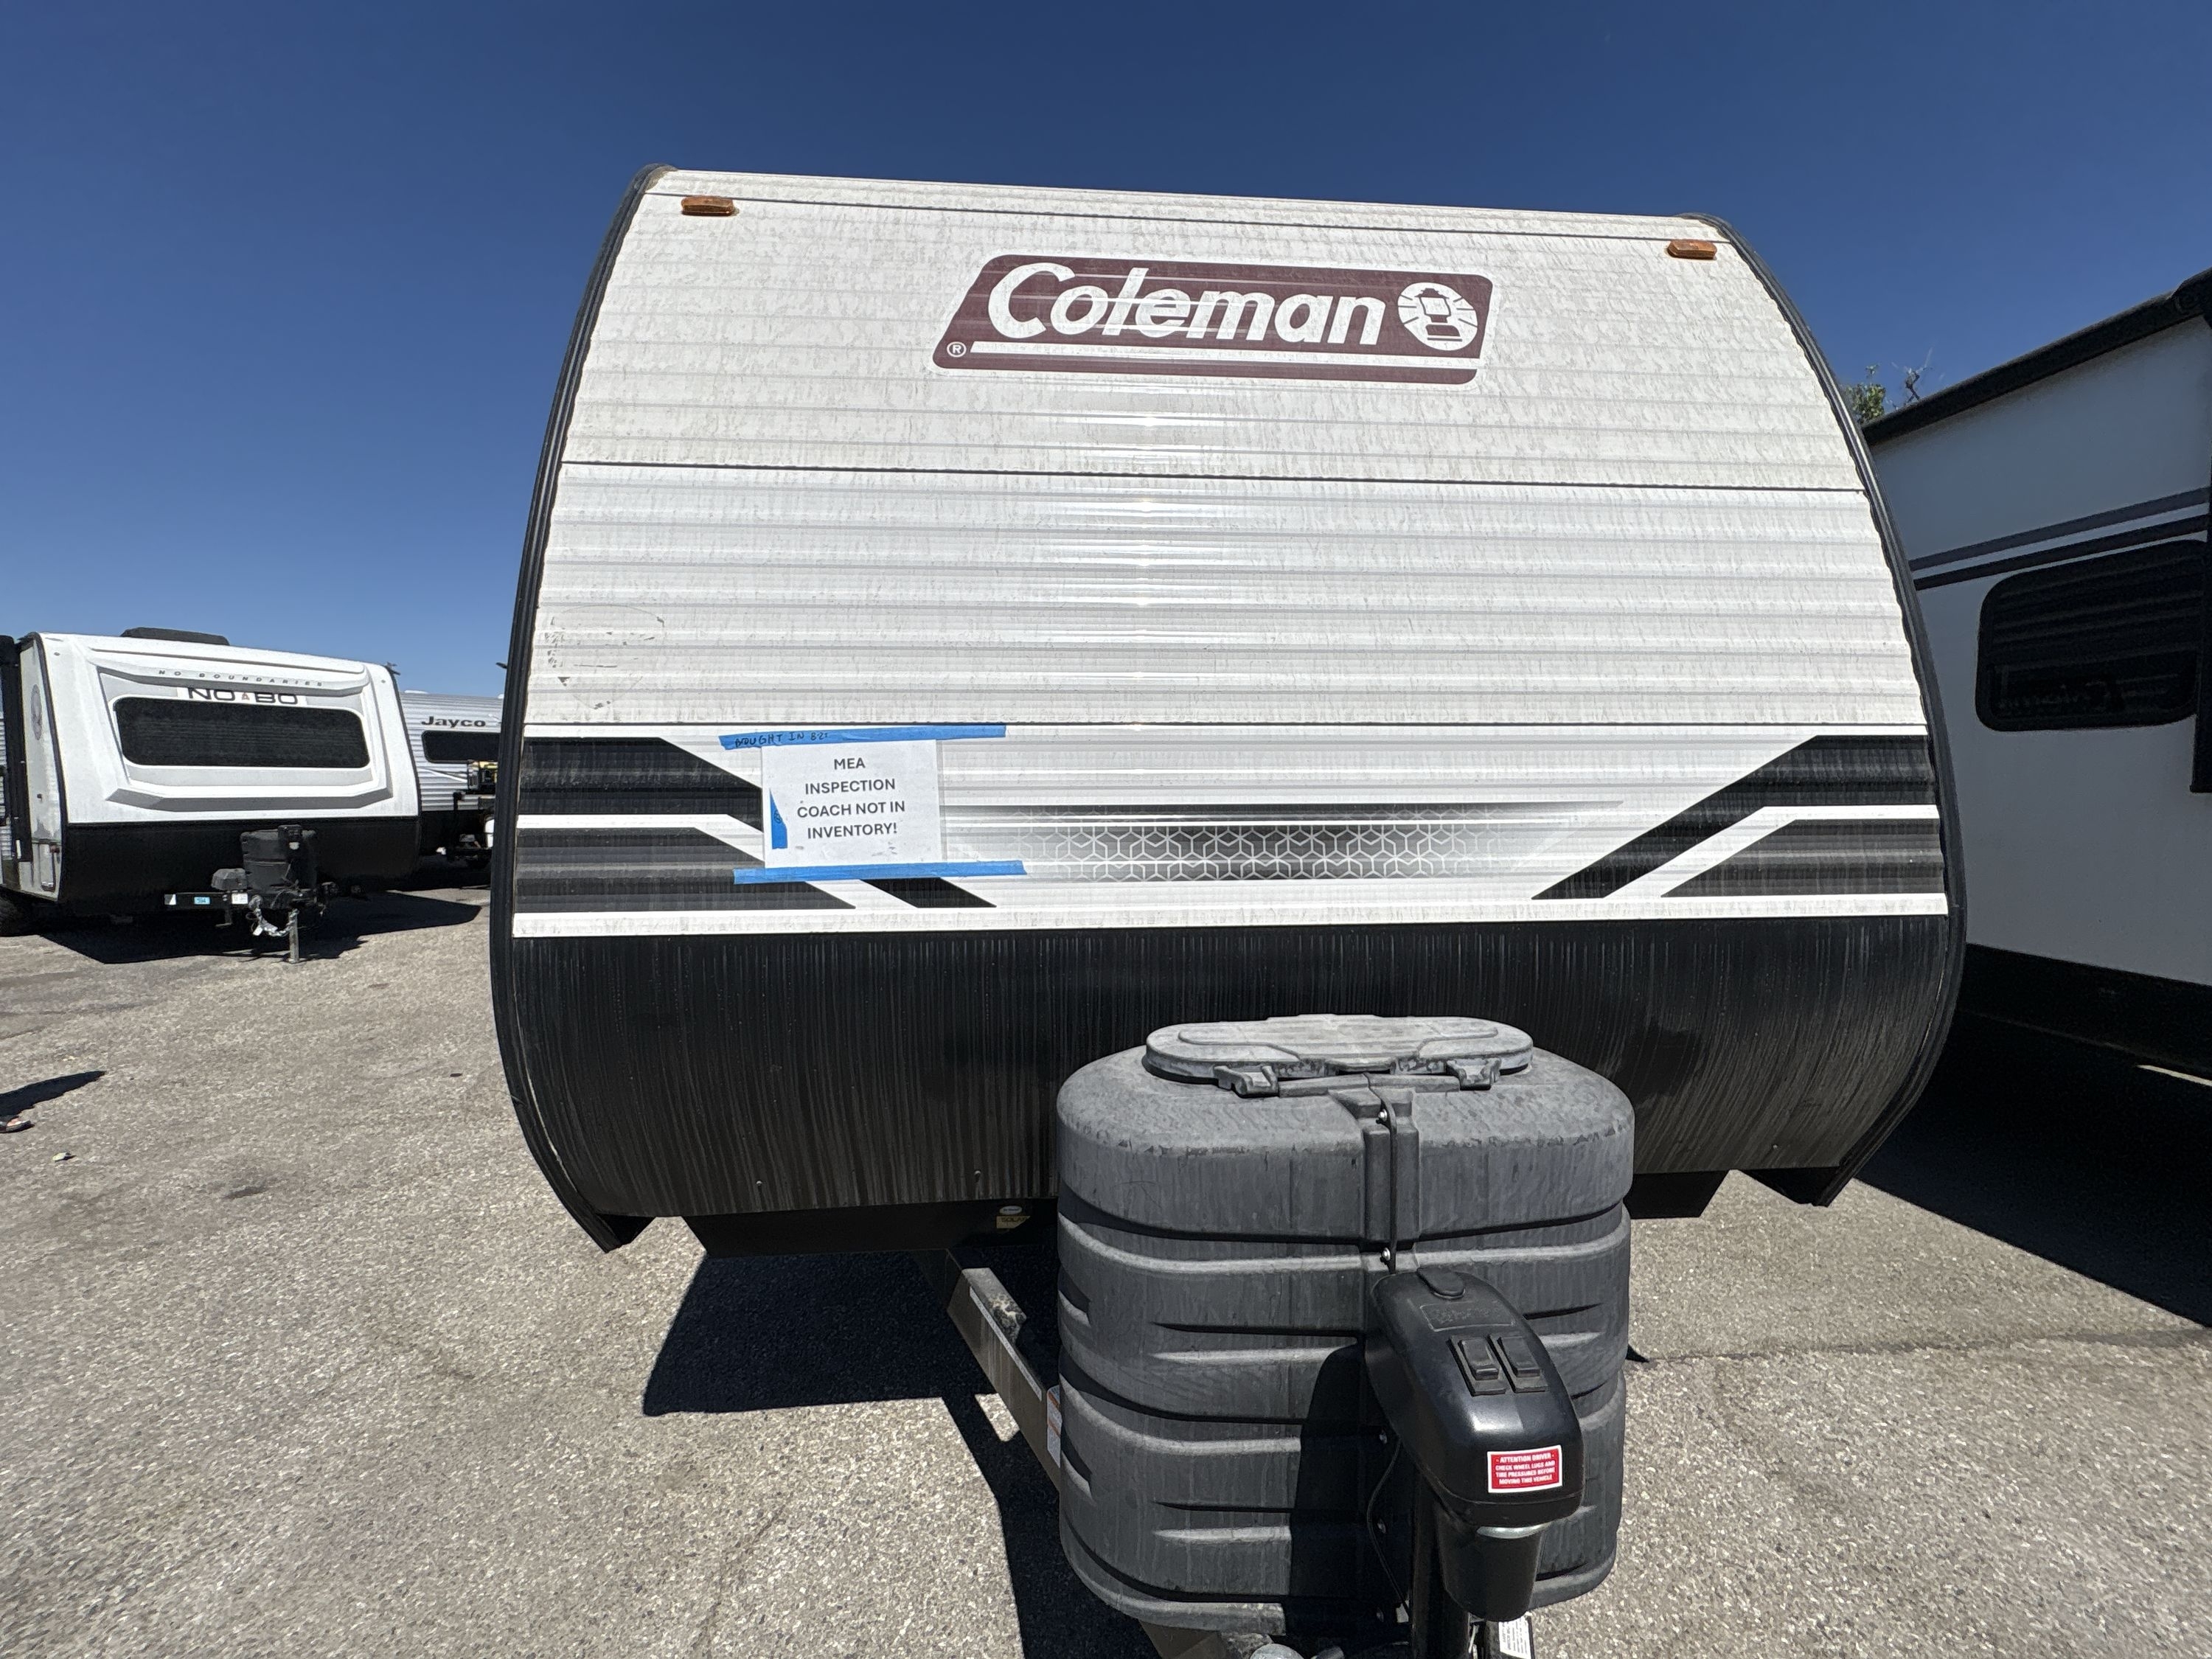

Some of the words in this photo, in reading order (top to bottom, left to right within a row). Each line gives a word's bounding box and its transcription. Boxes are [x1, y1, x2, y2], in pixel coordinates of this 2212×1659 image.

[987, 261, 1386, 345] Coleman
[198, 672, 323, 686] BOUNDARIES
[421, 716, 487, 728] Jayco
[789, 732, 805, 741] IN
[834, 757, 866, 770] MEA
[805, 778, 896, 795] INSPECTION
[797, 803, 852, 818] COACH
[856, 802, 886, 815] NOT
[890, 801, 905, 813] IN
[807, 822, 898, 839] INVENTORY!
[1500, 1455, 1531, 1464] ATTENTION
[1532, 1453, 1551, 1461] DRIVER
